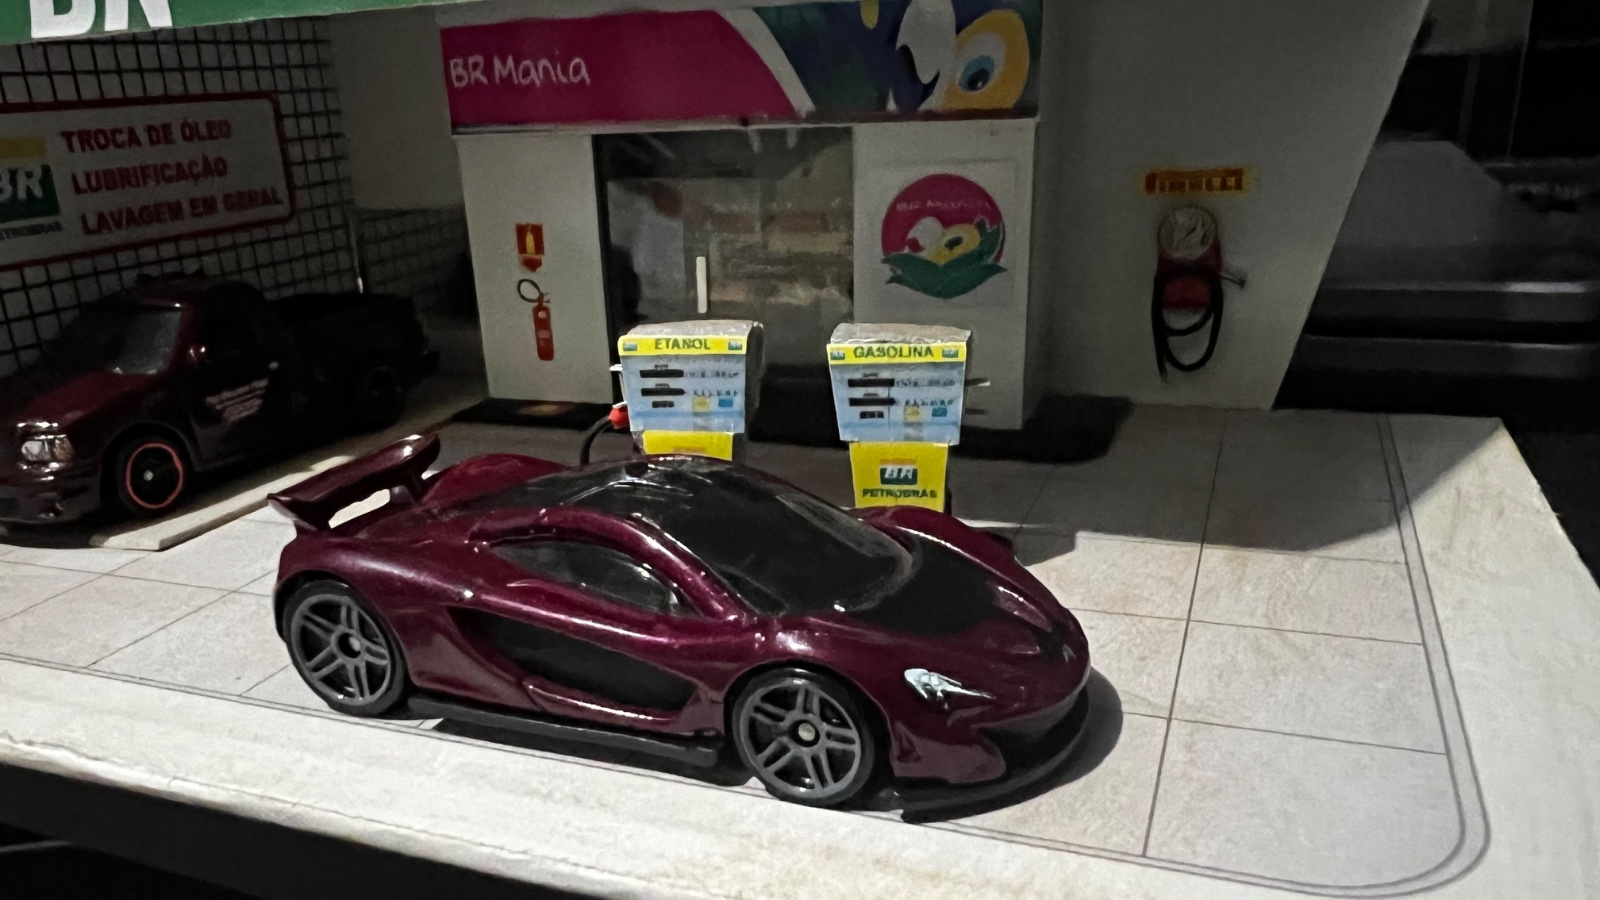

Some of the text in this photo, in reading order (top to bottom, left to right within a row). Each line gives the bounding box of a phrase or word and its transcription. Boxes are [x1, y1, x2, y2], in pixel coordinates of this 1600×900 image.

[449, 48, 590, 88] BR Mania
[60, 117, 232, 153] TROCA DE ÓLEO
[72, 152, 229, 195] LUBRIFICAÇÃO
[81, 200, 185, 235] LAVAGEM
[188, 194, 219, 218] EM
[222, 186, 284, 212] GERAL
[654, 337, 711, 350] ETANOL
[853, 345, 935, 359] GASOLINA
[884, 465, 914, 480] BR
[862, 487, 938, 499] PETROBRAS
